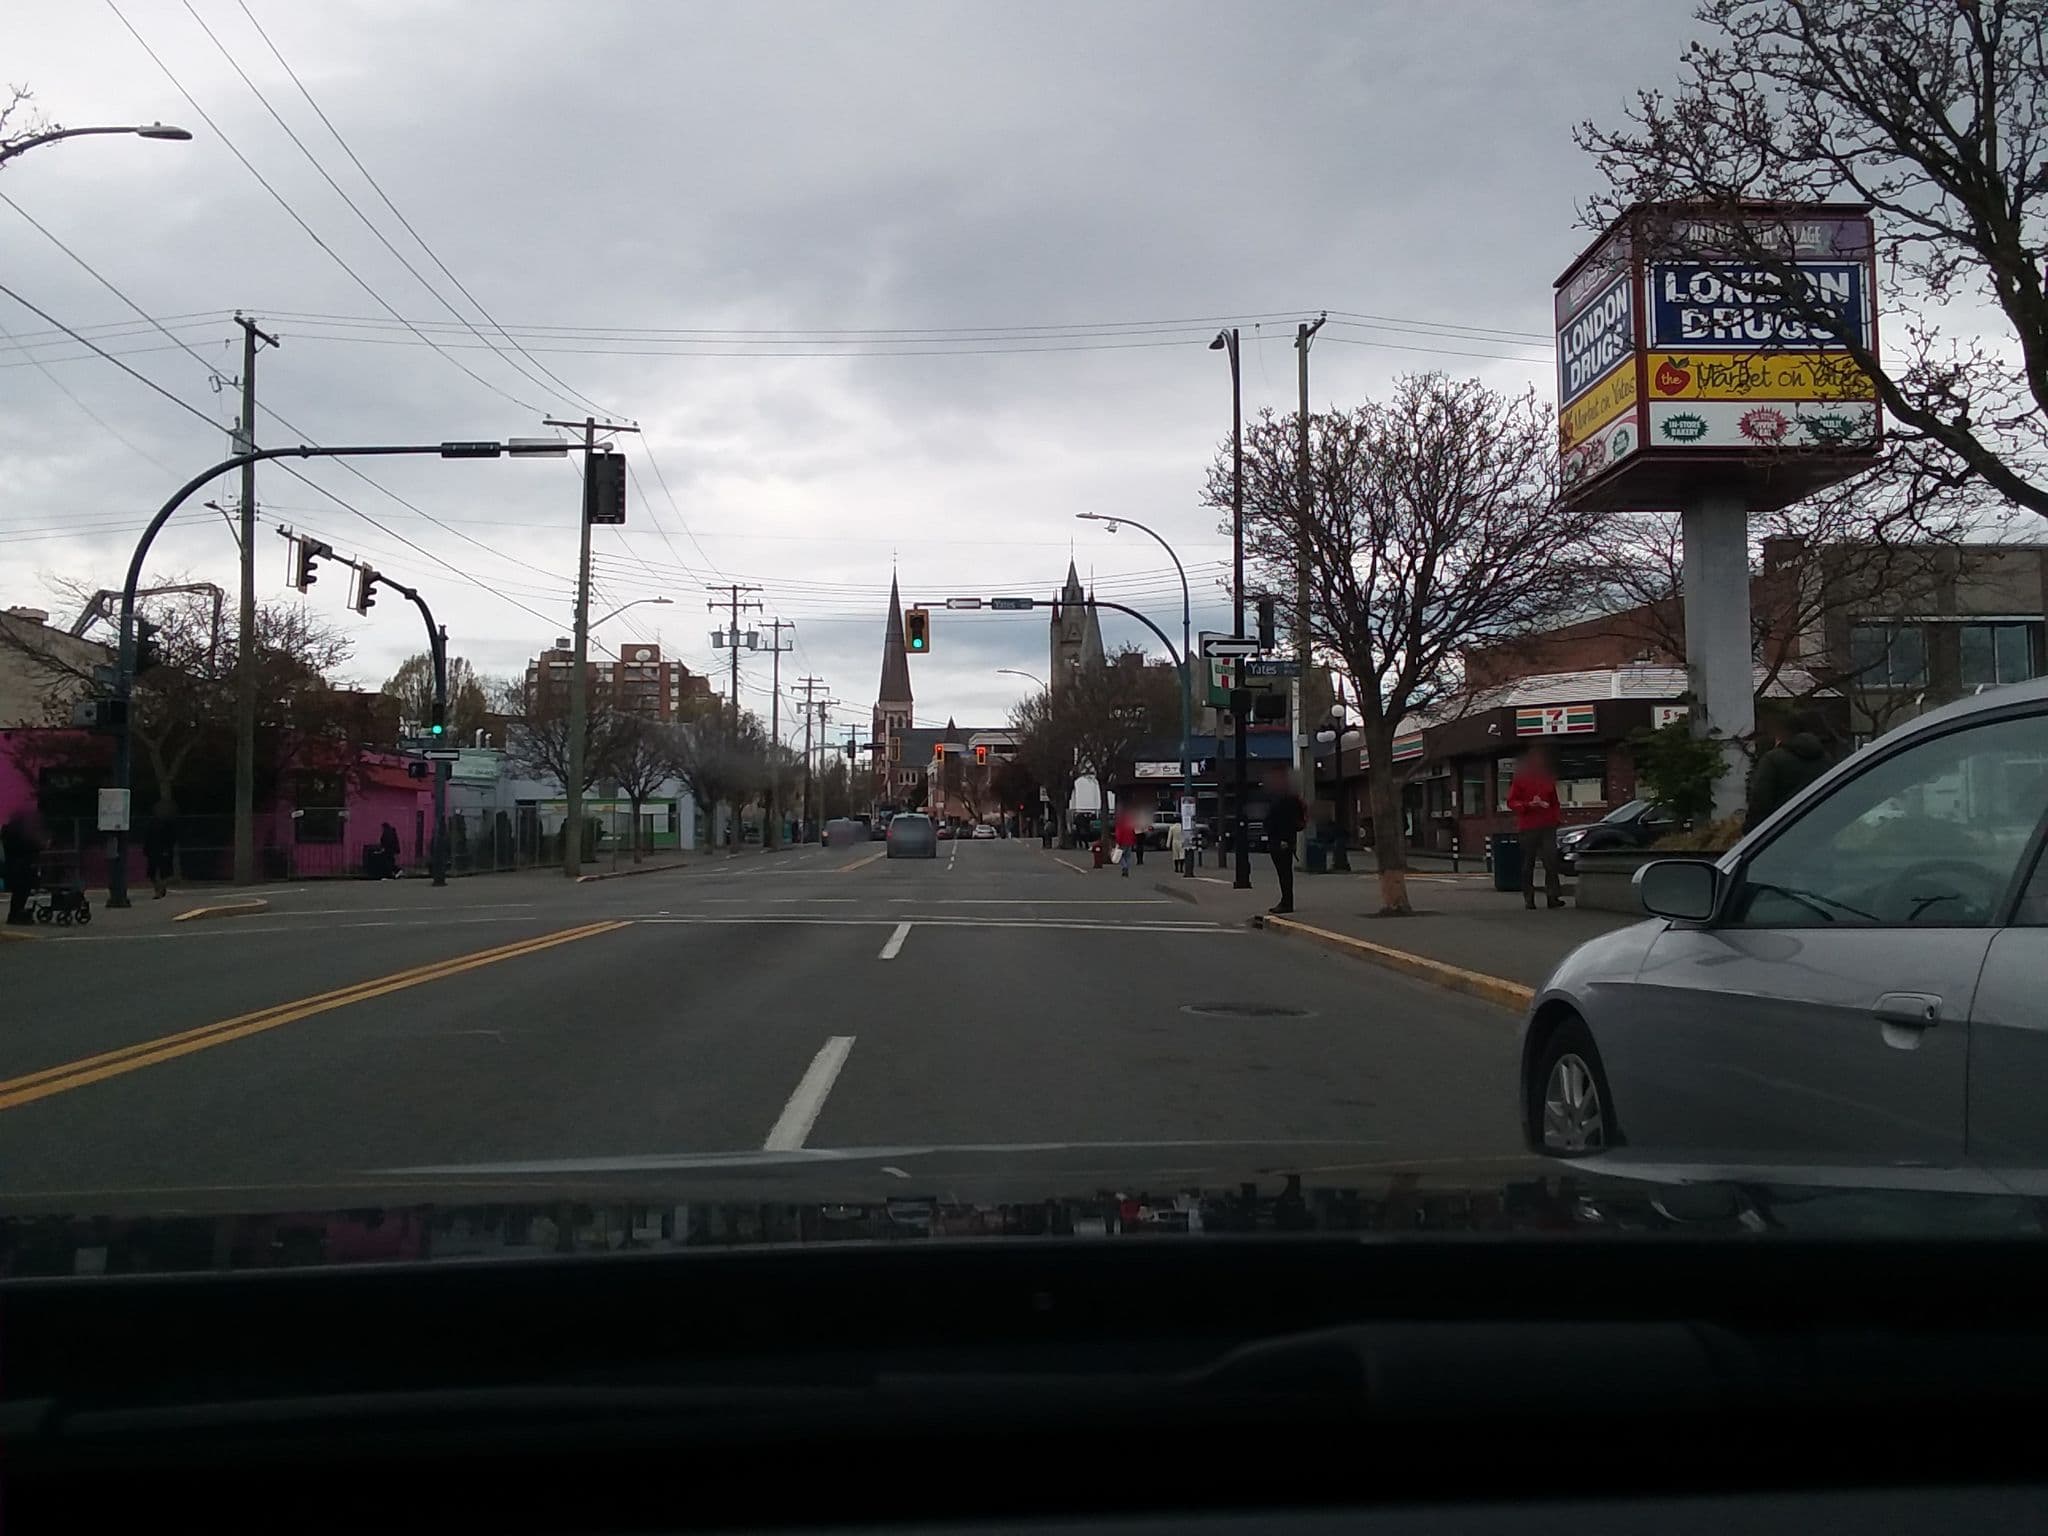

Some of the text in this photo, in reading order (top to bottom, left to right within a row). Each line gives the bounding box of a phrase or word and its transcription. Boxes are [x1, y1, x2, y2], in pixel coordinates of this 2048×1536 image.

[1564, 282, 1627, 363] LONDON
[1570, 323, 1624, 392] DRUGS
[1661, 371, 1682, 385] the
[1778, 370, 1805, 387] on
[1250, 663, 1277, 675] Yates
